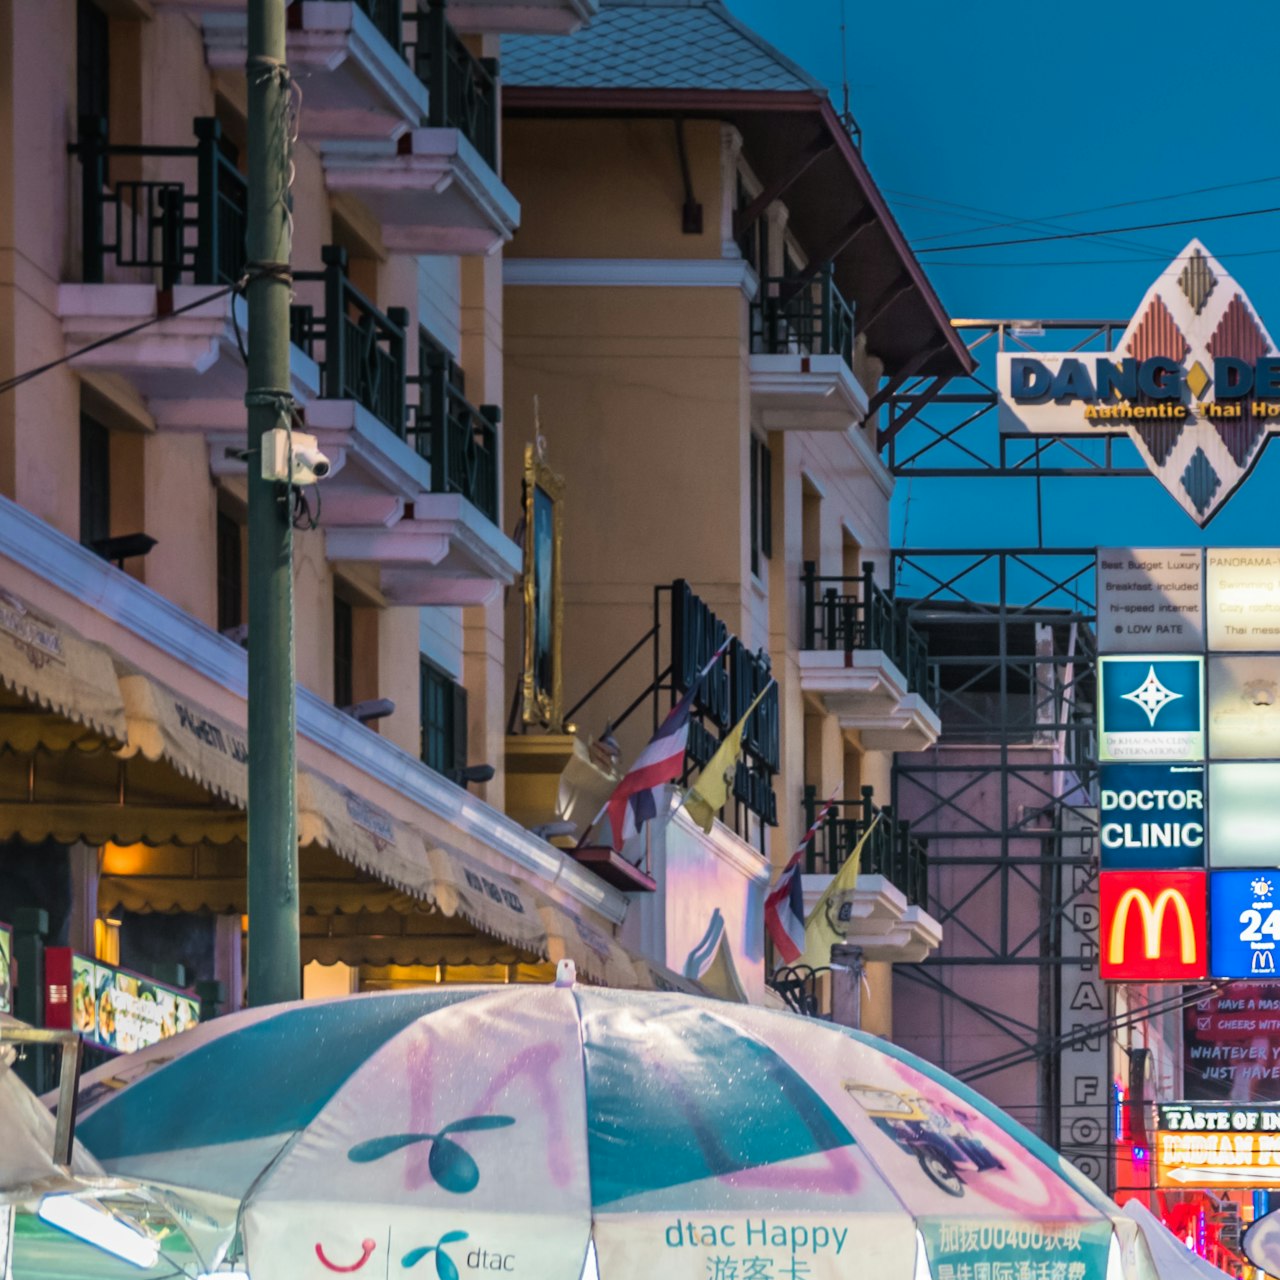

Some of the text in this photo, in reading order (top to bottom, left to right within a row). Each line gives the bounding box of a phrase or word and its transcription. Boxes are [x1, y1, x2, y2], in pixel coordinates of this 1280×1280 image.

[1010, 357, 1184, 400] DANG
[1084, 401, 1186, 419] Authentic
[1199, 401, 1241, 419] Thai
[1101, 560, 1200, 572] Best Budget Luxury
[1106, 582, 1199, 591] Breakfast included
[1110, 603, 1199, 613] hi-speed internet
[1127, 625, 1183, 634] LOW RATE
[1225, 625, 1247, 634] Thai
[1101, 790, 1203, 811] DOCTOR
[1101, 823, 1203, 848] CLINIC
[1071, 827, 1103, 1052] INDIAN
[1218, 999, 1244, 1009] HAVE
[1248, 1000, 1255, 1008] A
[1217, 1019, 1256, 1029] CHEERS
[1190, 1046, 1266, 1059] WHATEVER
[1202, 1066, 1235, 1080] JUST
[1243, 1066, 1280, 1079] HAVE
[1166, 1111, 1230, 1130] TASTE
[1233, 1112, 1259, 1129] OF
[1163, 1134, 1253, 1165] INDIAN
[665, 1219, 849, 1255] dtac Happy
[466, 1247, 515, 1272] dtac
